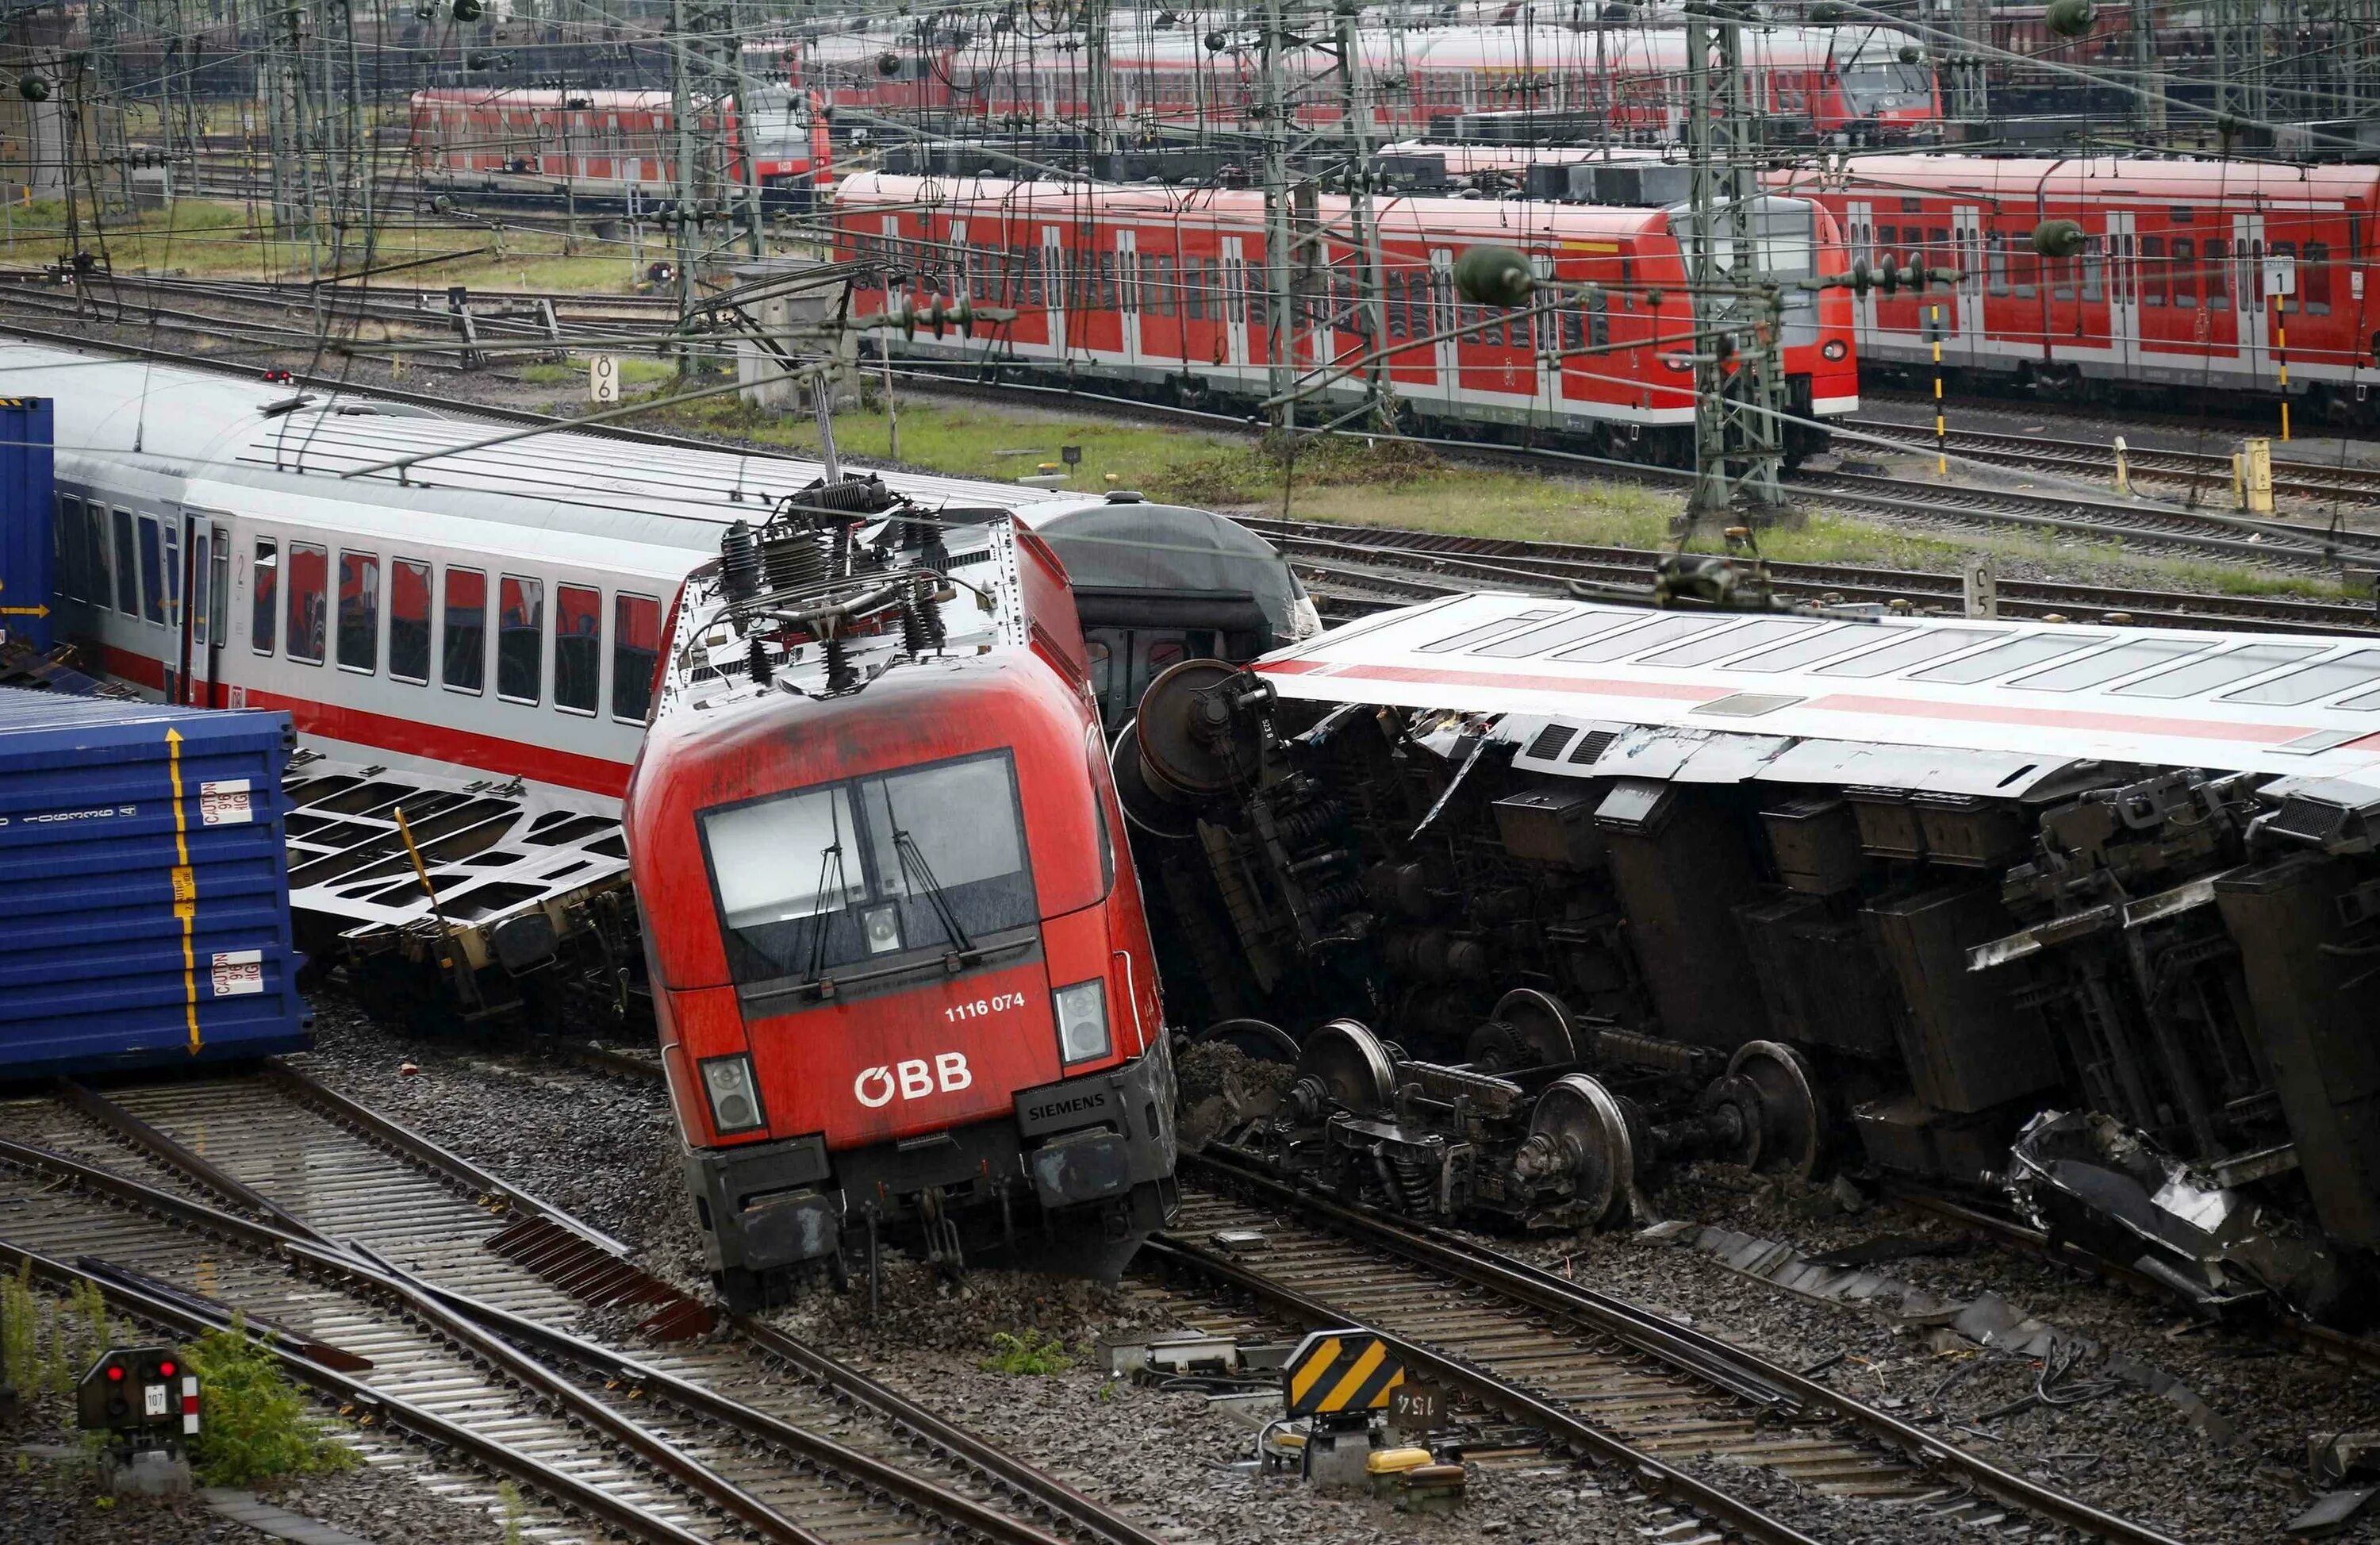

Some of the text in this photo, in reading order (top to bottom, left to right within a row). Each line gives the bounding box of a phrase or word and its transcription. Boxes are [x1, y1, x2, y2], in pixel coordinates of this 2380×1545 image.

[2276, 272, 2283, 292] 1
[598, 380, 611, 398] 6
[1261, 718, 1272, 732] 523
[22, 809, 114, 823] 106336
[119, 805, 136, 817] 4
[945, 992, 1026, 1023] 1116 074
[1029, 1093, 1105, 1121] SIEMENS
[148, 1393, 163, 1407] 107
